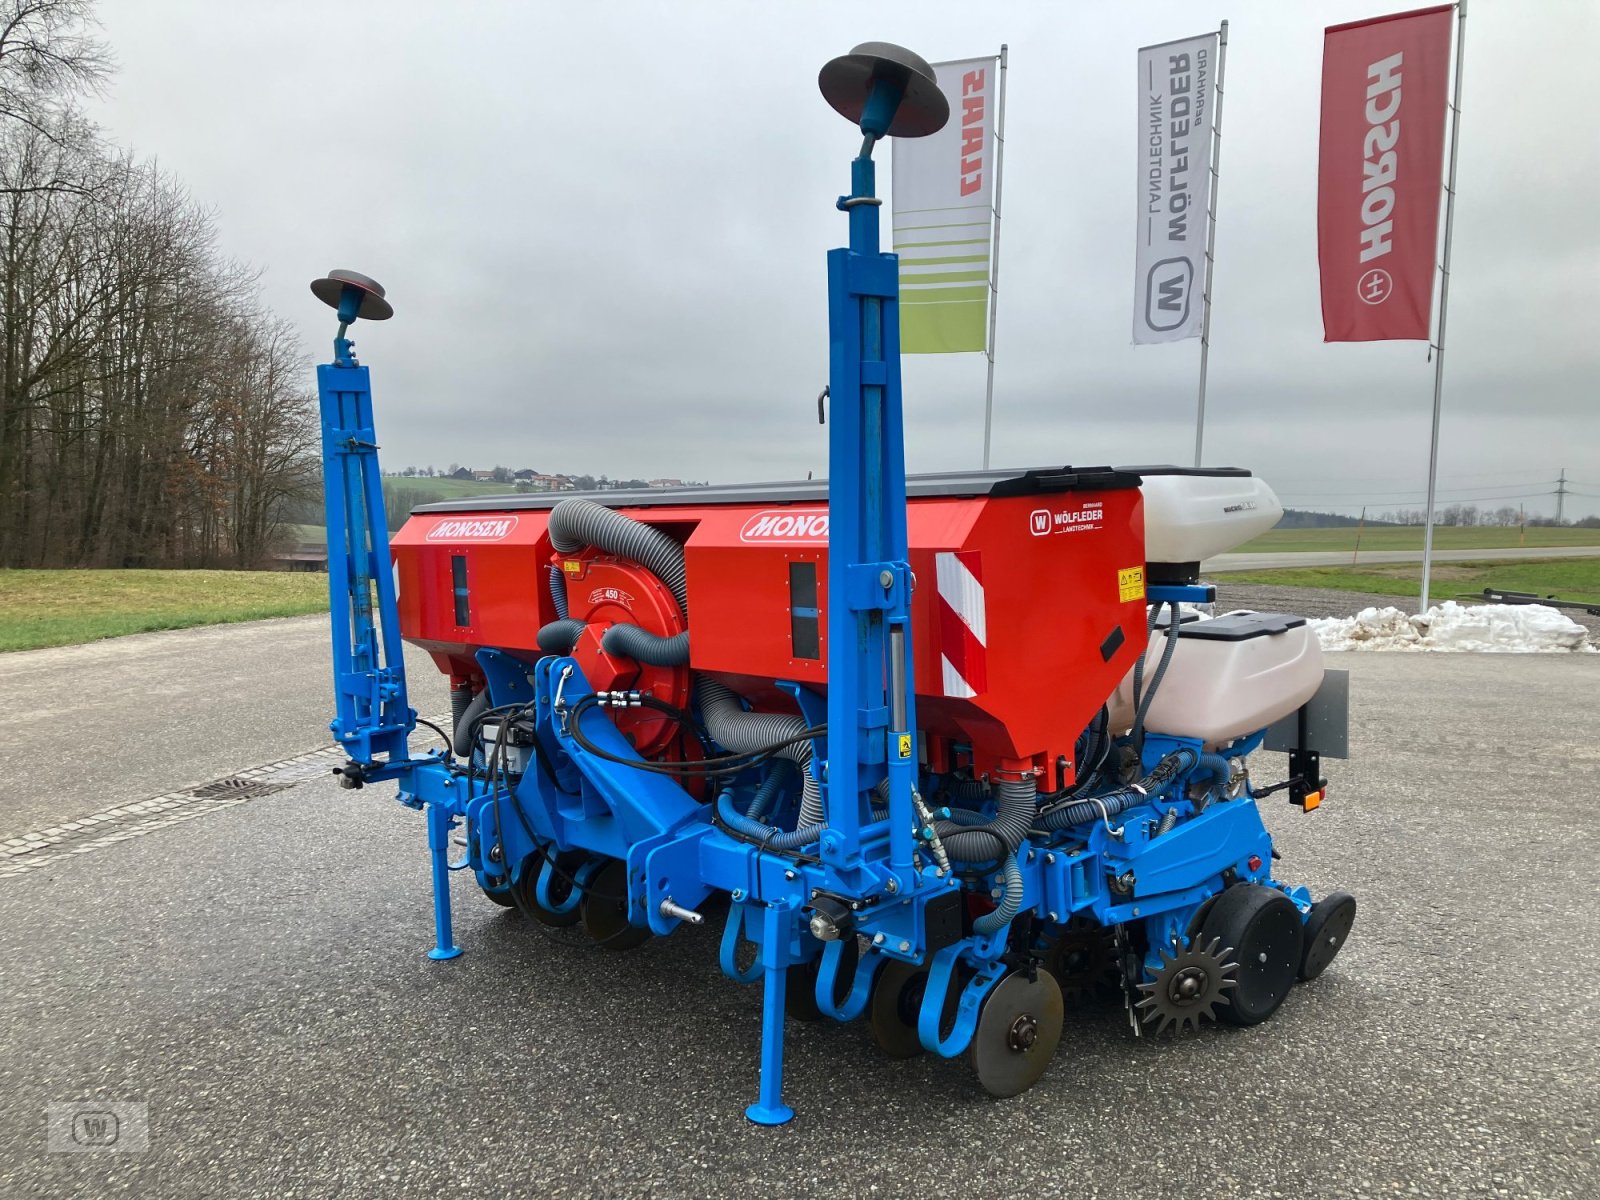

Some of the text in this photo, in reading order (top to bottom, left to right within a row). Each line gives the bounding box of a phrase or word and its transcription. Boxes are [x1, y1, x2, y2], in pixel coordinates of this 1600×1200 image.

[1034, 515, 1047, 530] W
[1054, 509, 1103, 525] WÖLFLEDER
[429, 520, 512, 537] MONOSEM
[744, 515, 829, 537] MONO
[1062, 523, 1095, 533] LANDTECHNIK
[605, 589, 618, 599] 450
